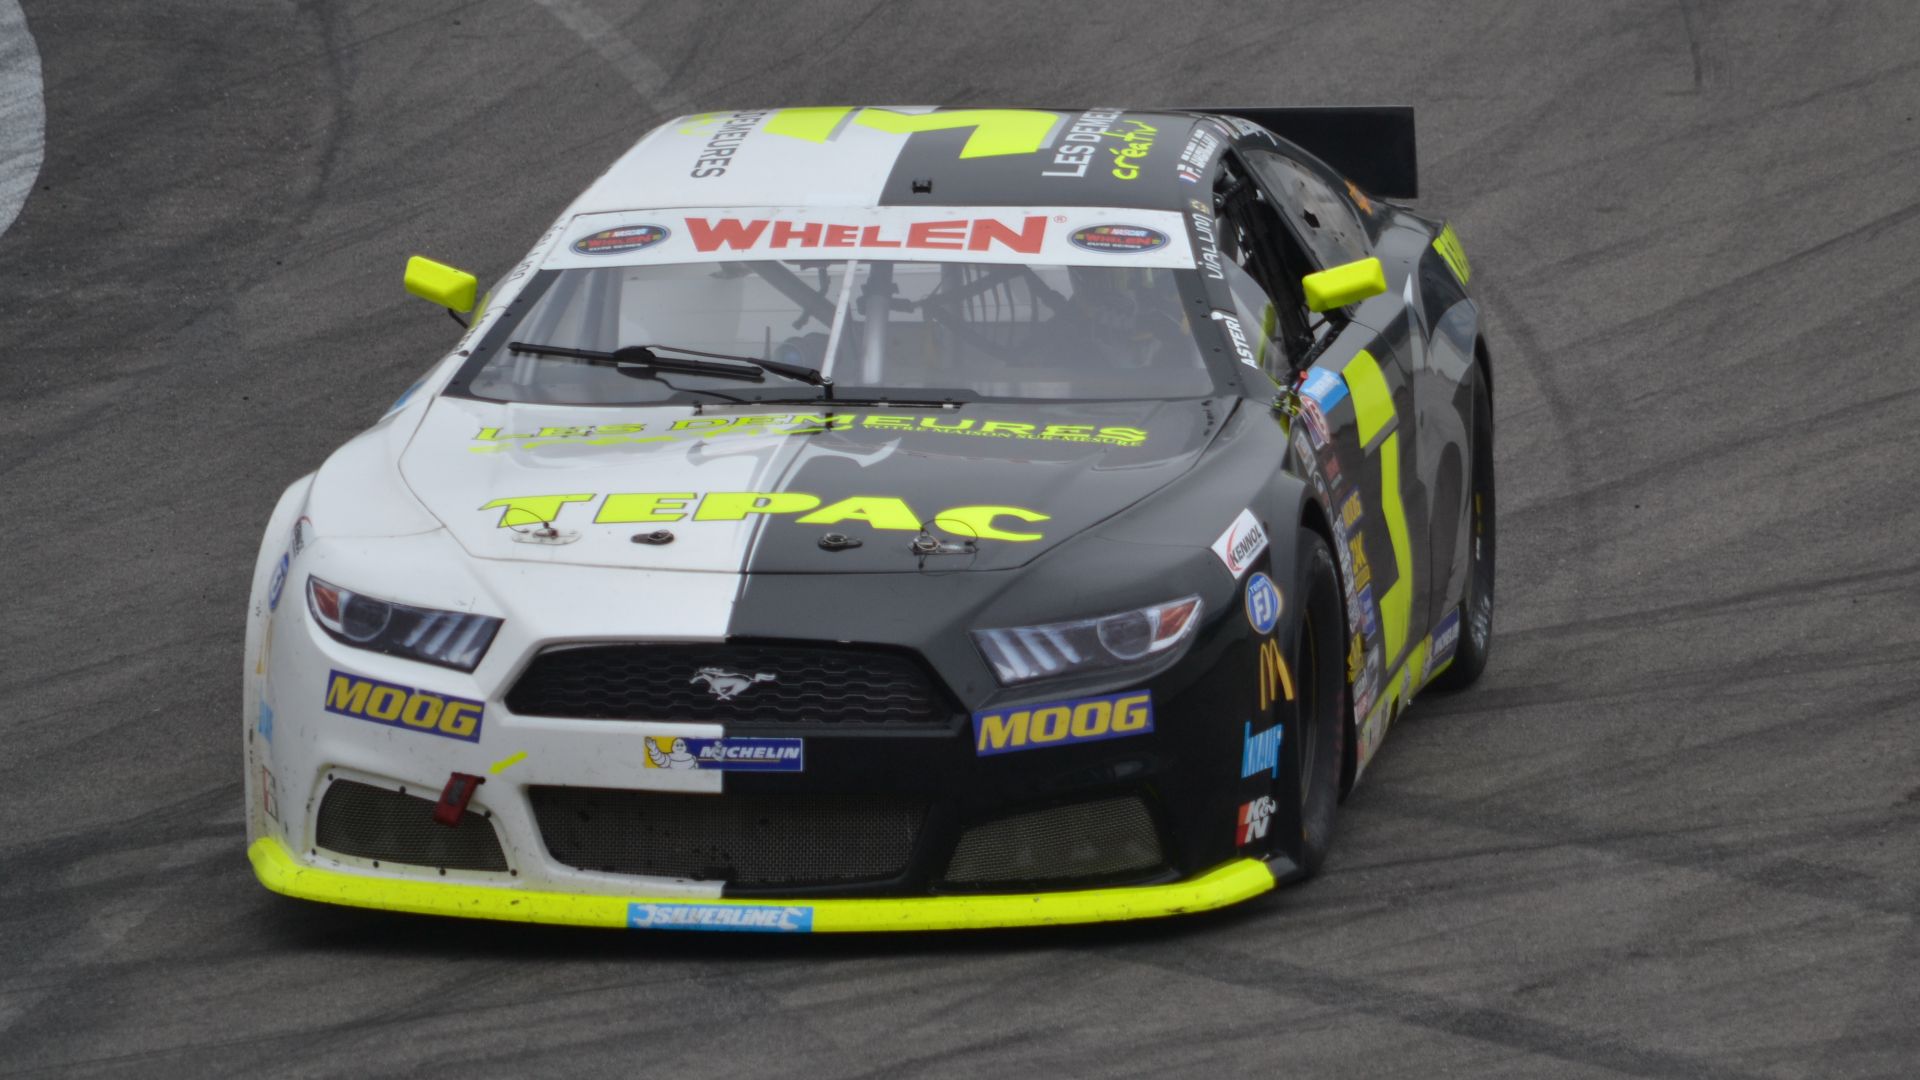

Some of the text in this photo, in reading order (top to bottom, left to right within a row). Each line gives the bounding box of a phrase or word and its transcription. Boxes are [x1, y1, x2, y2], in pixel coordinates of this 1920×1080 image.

[1041, 143, 1097, 178] LES
[684, 214, 1048, 254] WHELEN
[665, 412, 1148, 442] DEMEURES
[477, 491, 1052, 542] TEPAC
[1229, 525, 1262, 566] KENNOL
[326, 675, 483, 737] MOOG
[978, 695, 1150, 752] MOOG
[700, 743, 800, 760] MICHELIN
